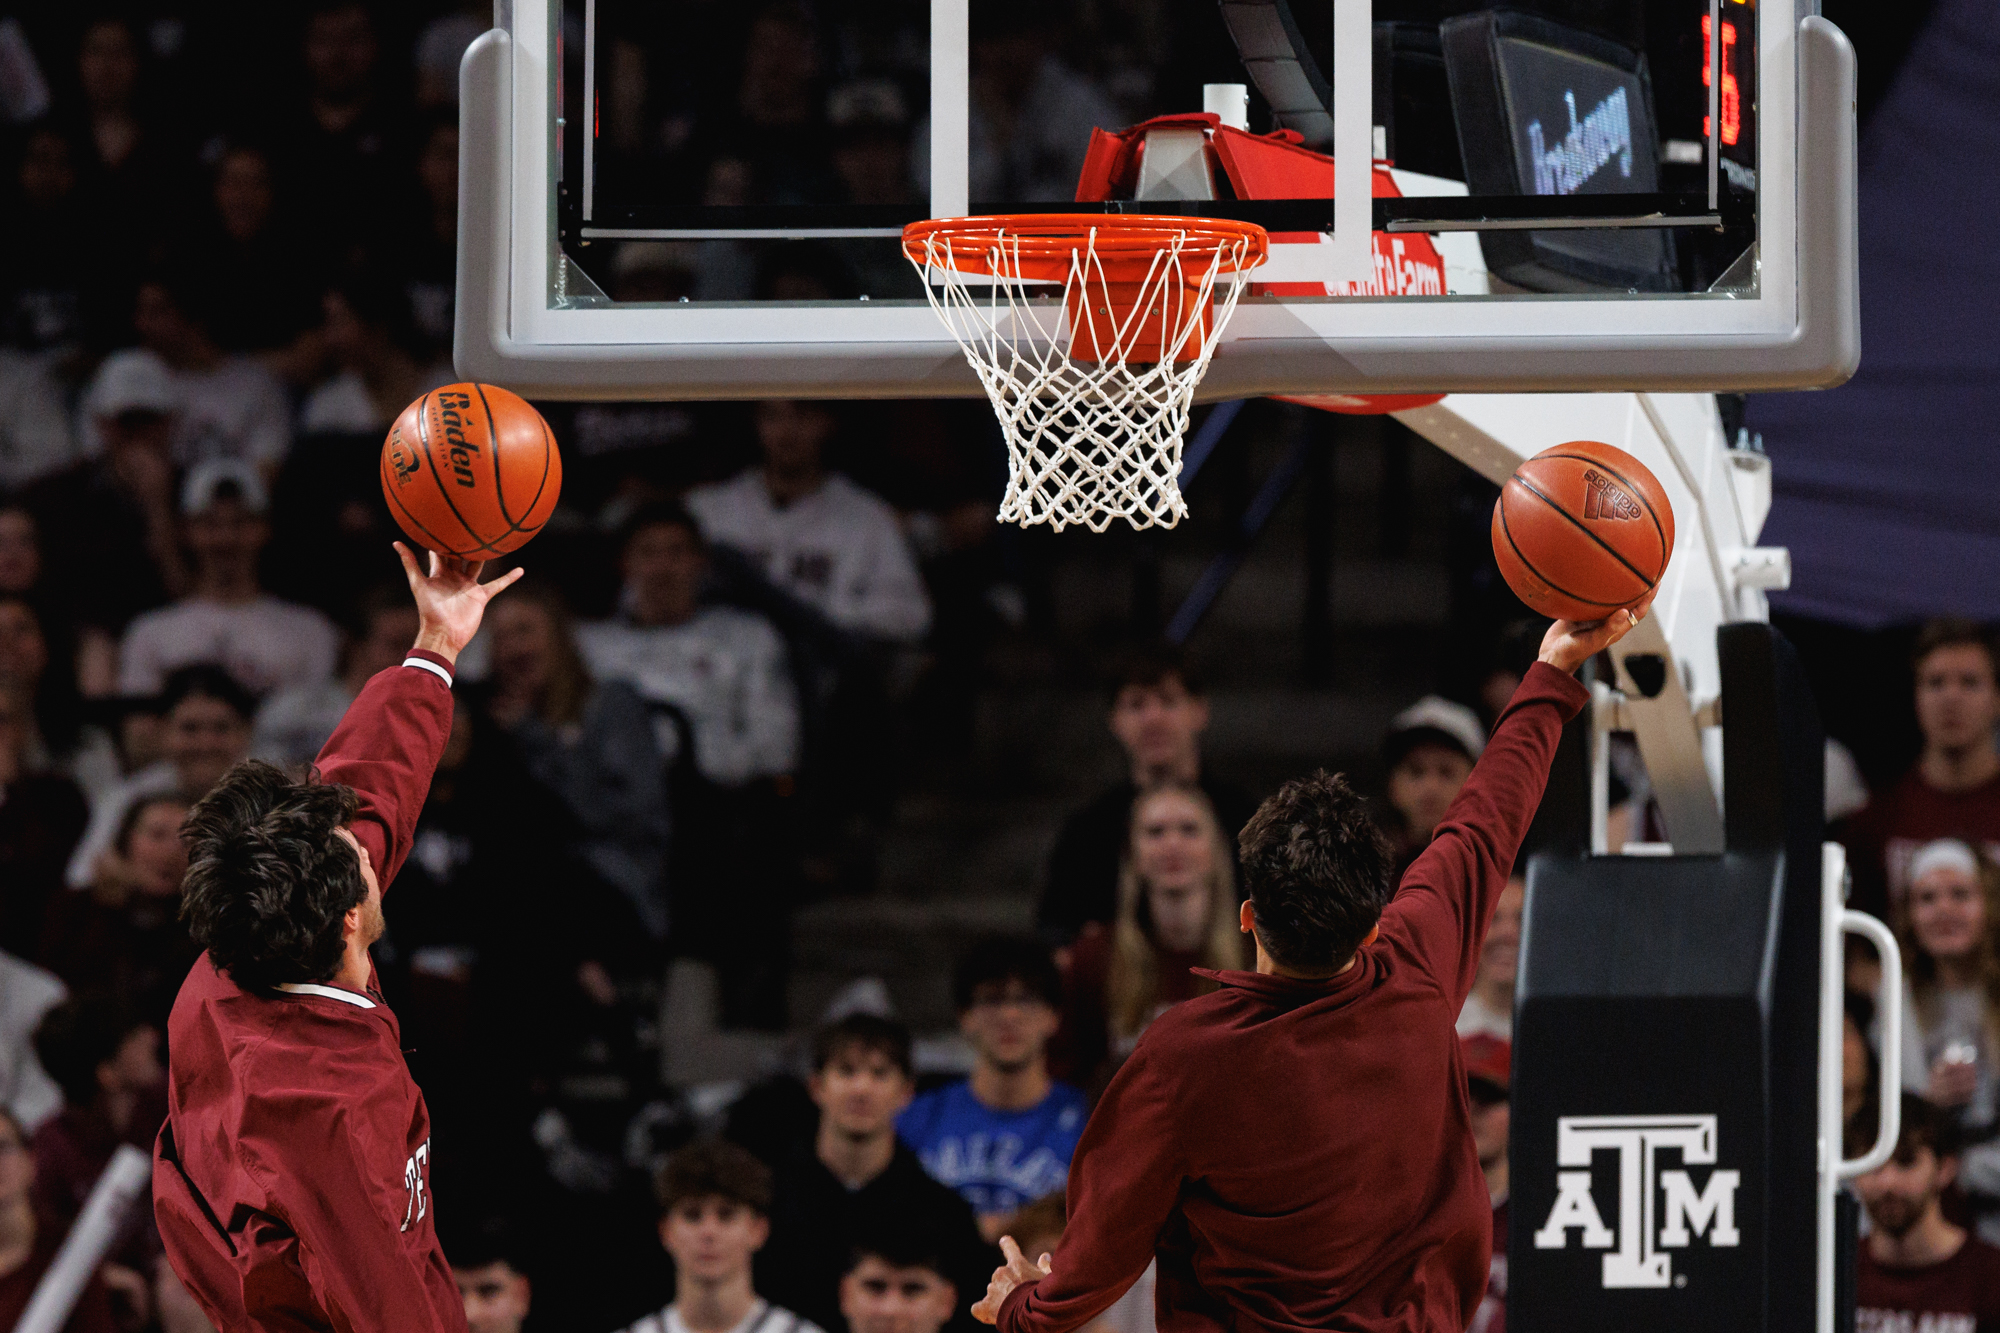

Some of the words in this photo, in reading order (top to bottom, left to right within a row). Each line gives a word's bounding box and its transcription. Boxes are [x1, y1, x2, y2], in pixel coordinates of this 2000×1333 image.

[438, 392, 480, 488] Baden
[1584, 469, 1642, 519] adidas
[400, 1136, 431, 1232] TE
